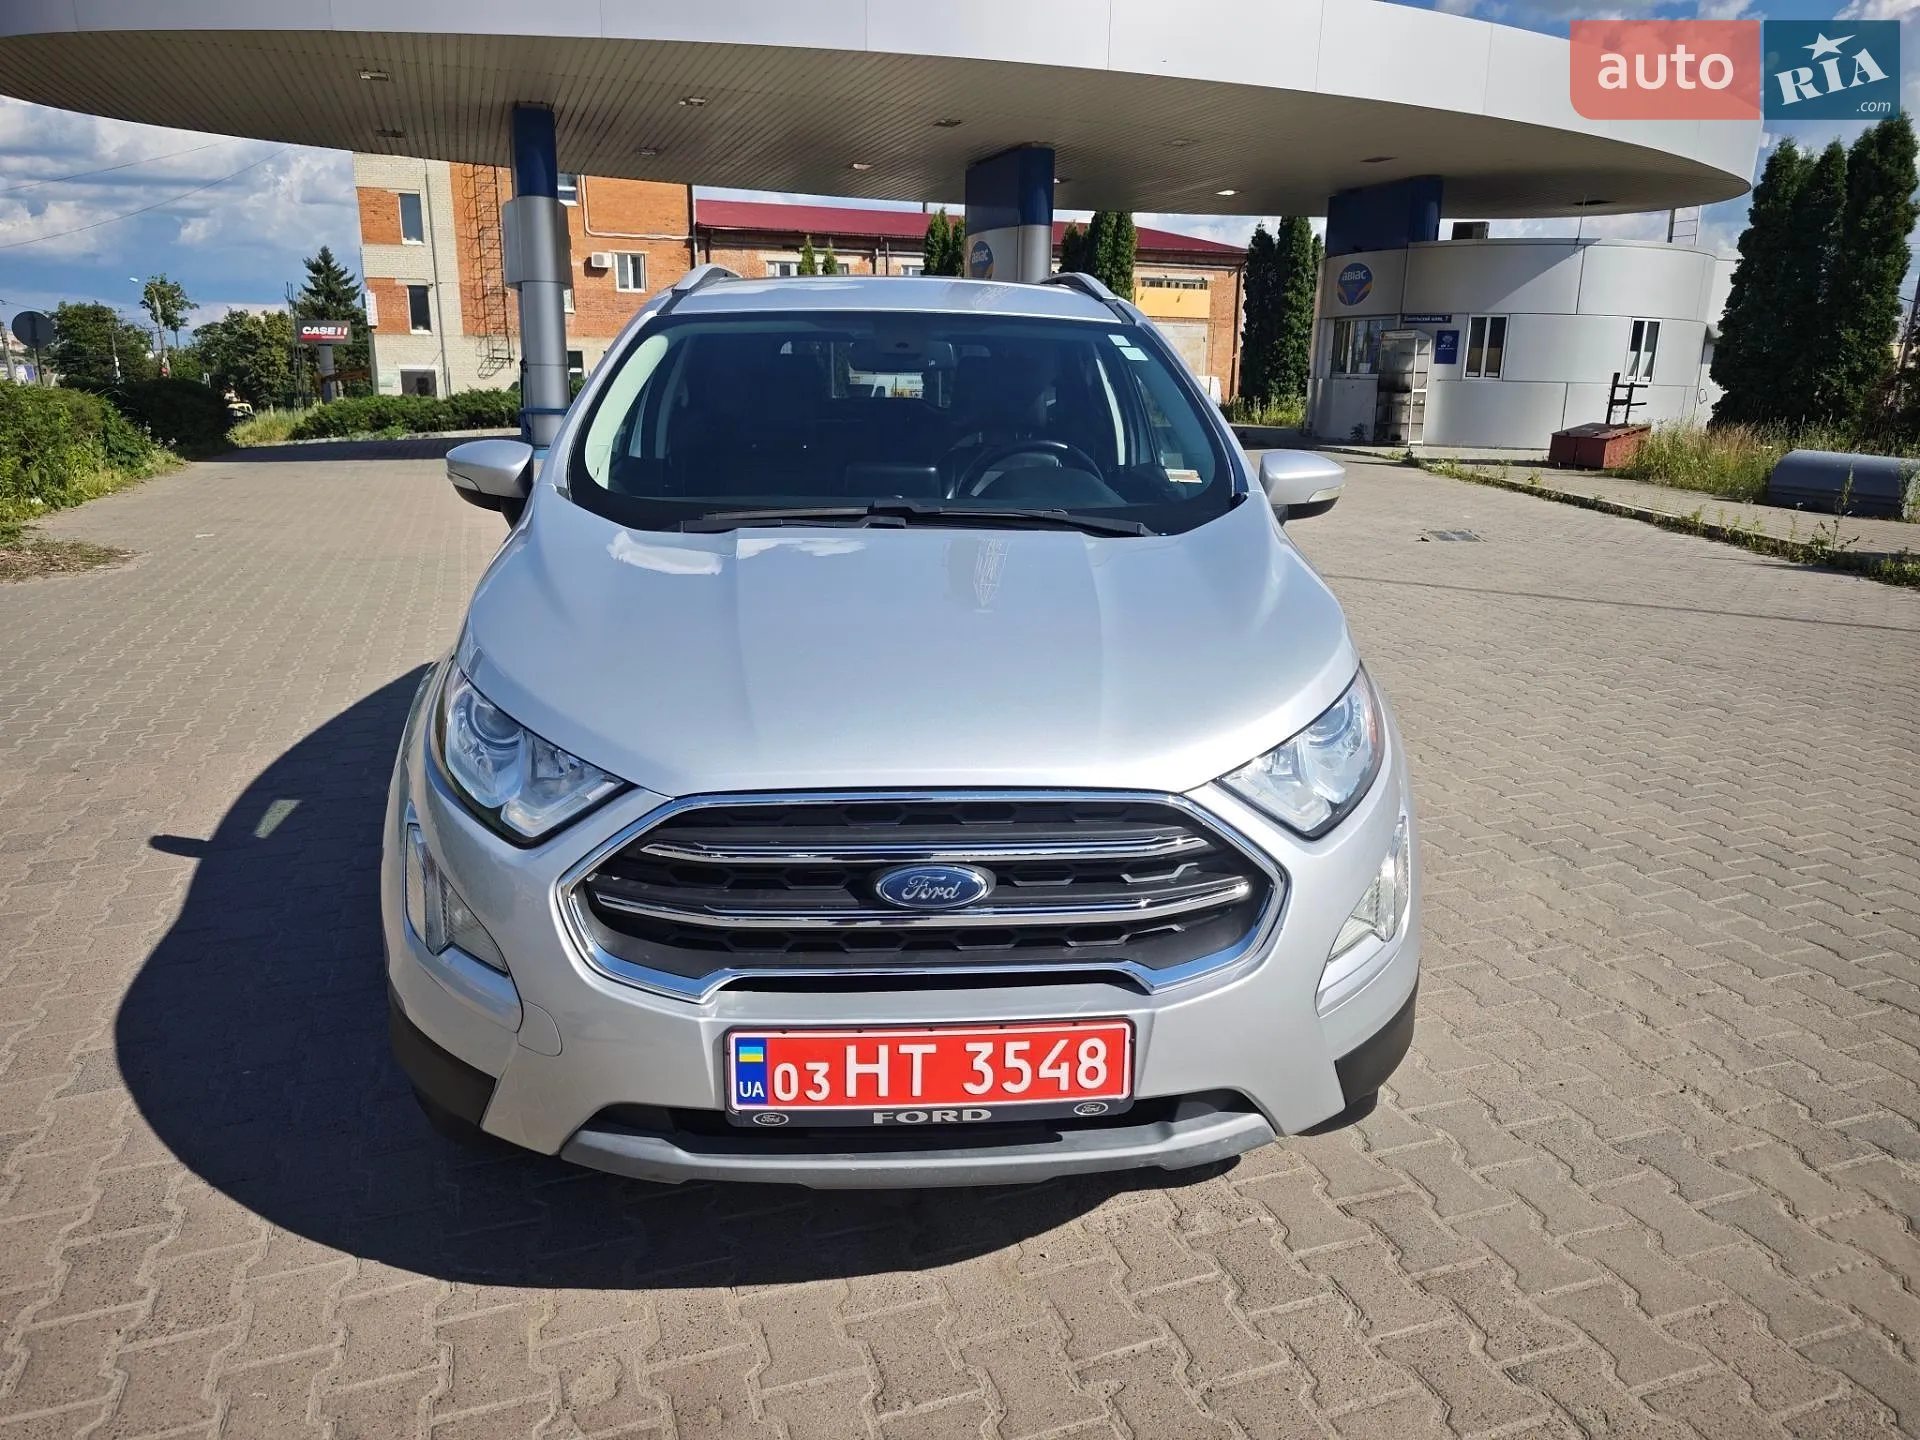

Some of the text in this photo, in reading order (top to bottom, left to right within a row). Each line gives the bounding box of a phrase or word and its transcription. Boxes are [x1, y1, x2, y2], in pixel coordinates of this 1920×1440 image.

[302, 326, 336, 335] CASE
[901, 874, 961, 900] Ford
[773, 1037, 1108, 1101] 03 HT 3548
[739, 1081, 765, 1098] UA
[873, 1108, 992, 1124] FORD
